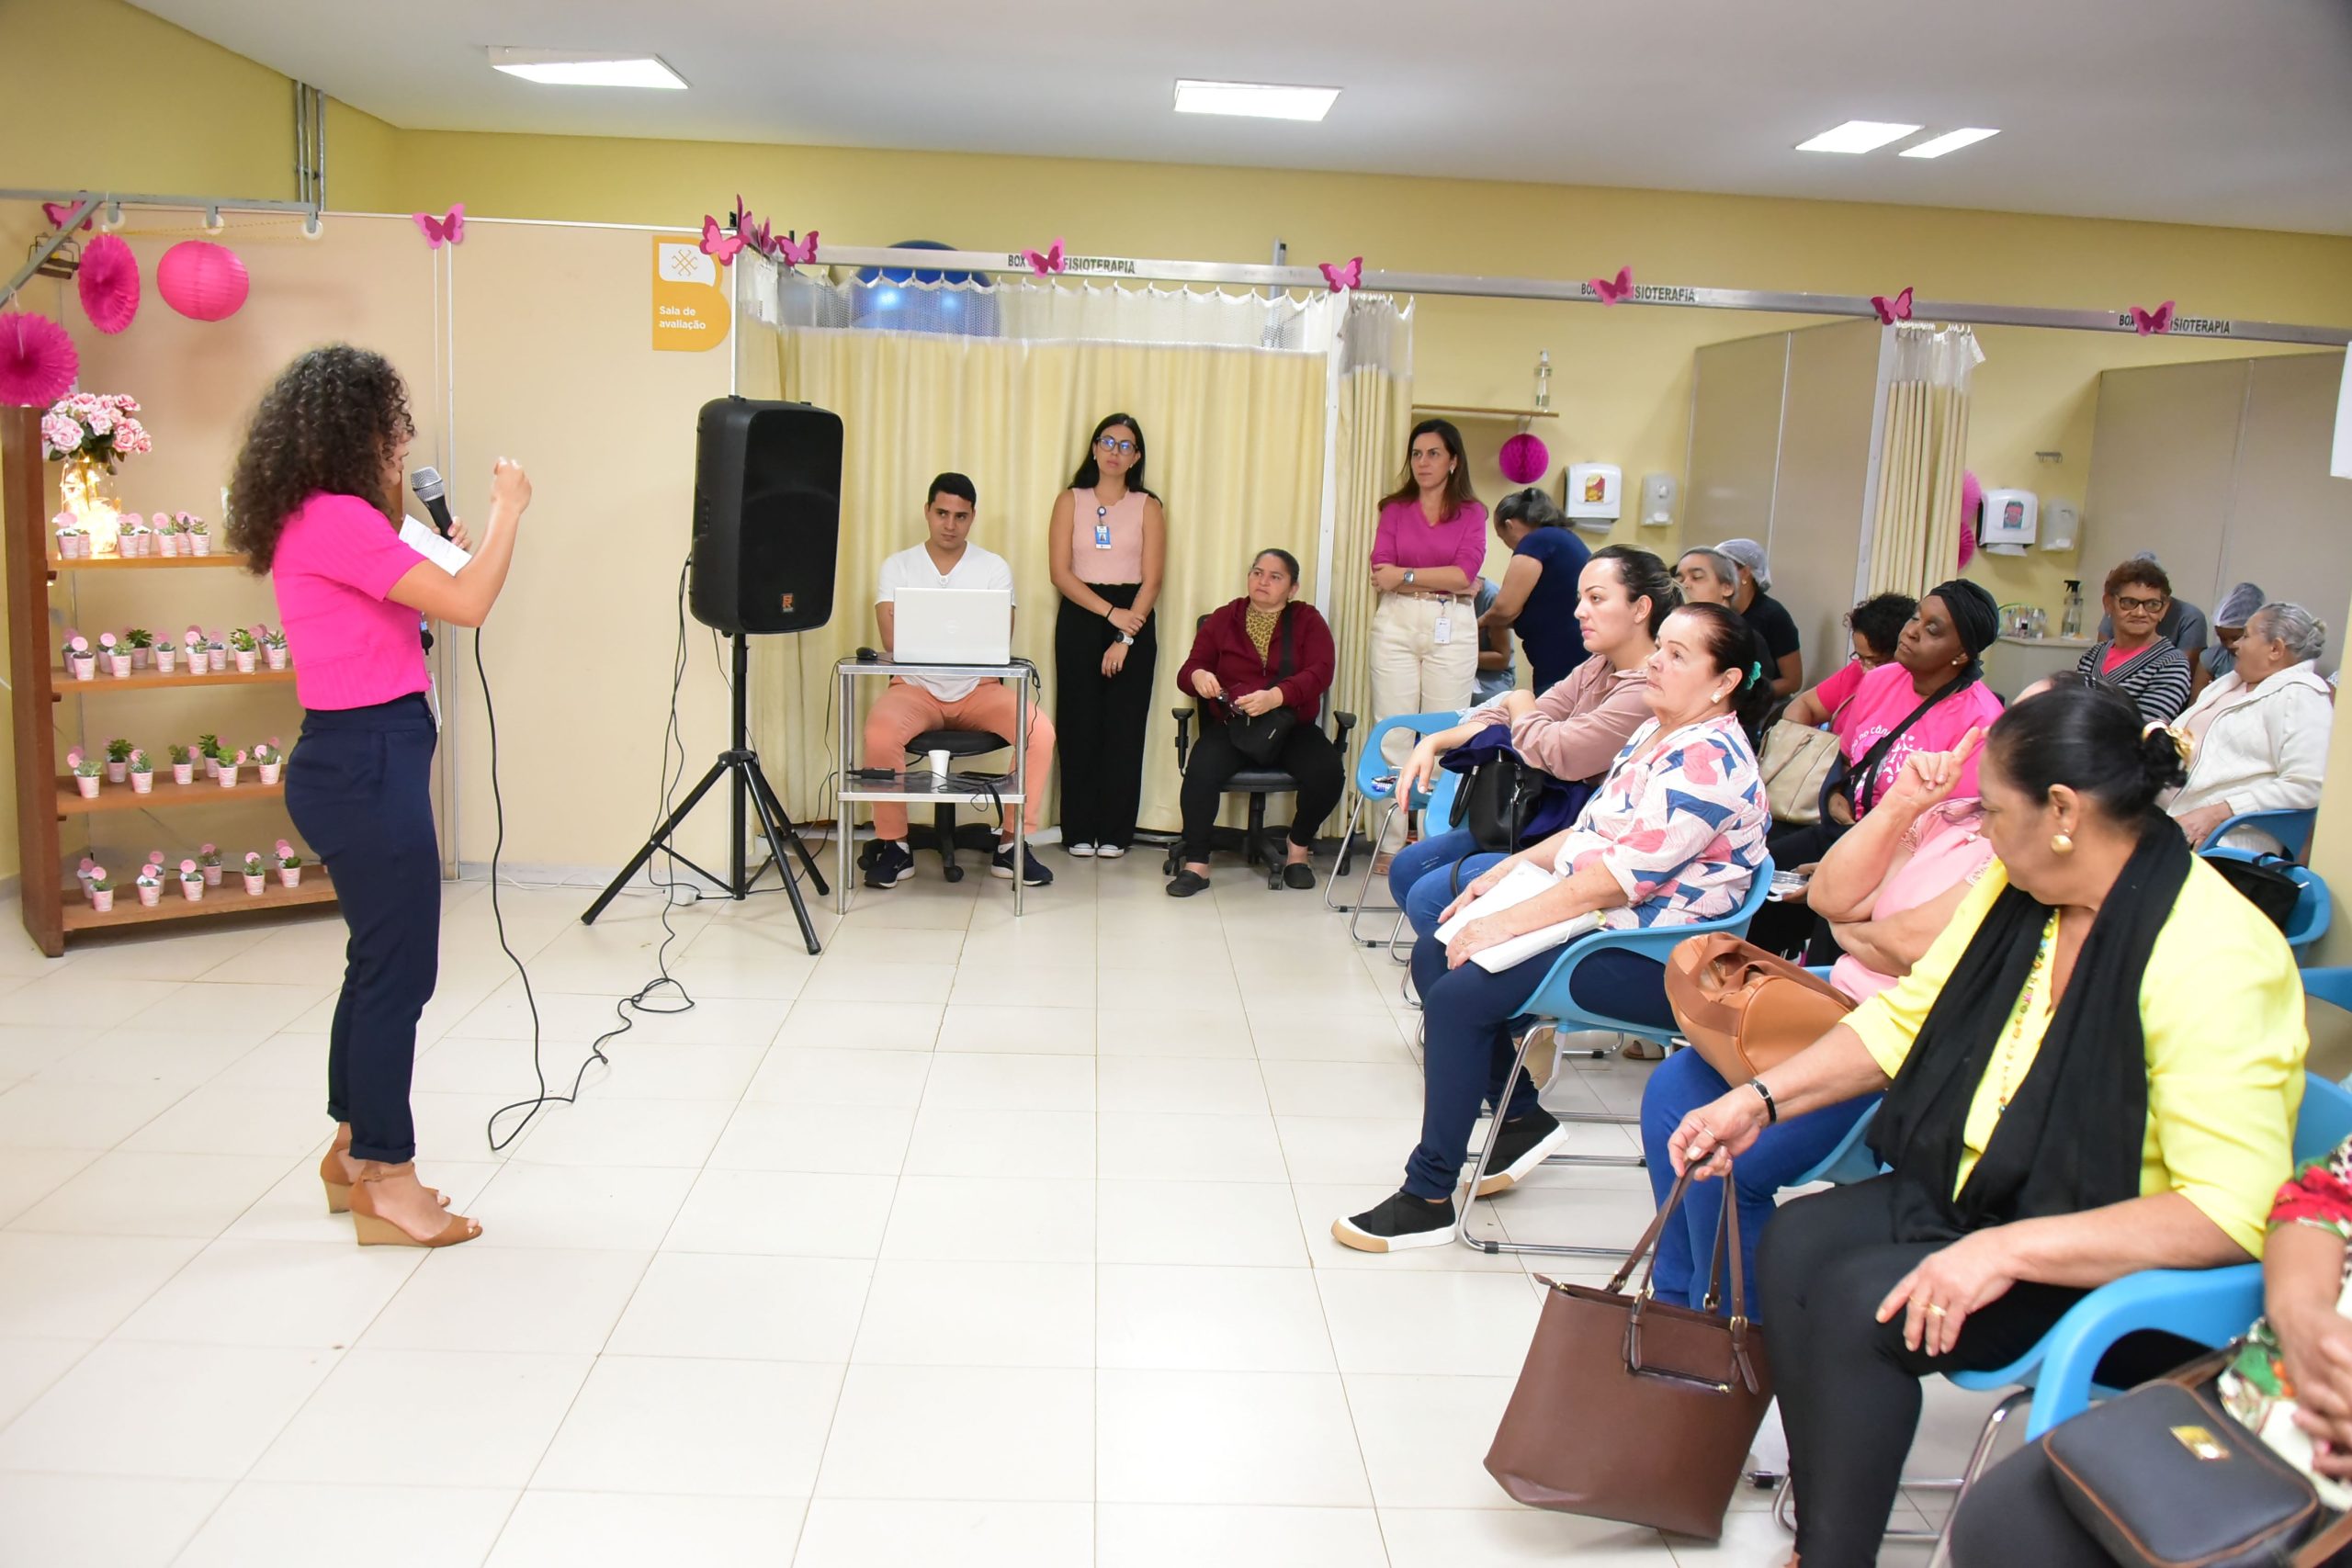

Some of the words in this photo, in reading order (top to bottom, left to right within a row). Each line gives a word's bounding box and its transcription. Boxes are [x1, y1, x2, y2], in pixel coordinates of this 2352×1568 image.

[1007, 254, 1026, 267] BOX
[1632, 285, 1696, 302] ISIOTERAPIA
[659, 305, 681, 316] Sala
[683, 306, 696, 316] de
[659, 319, 707, 331] avaliação
[2169, 318, 2231, 334] ISIOTERAPIA
